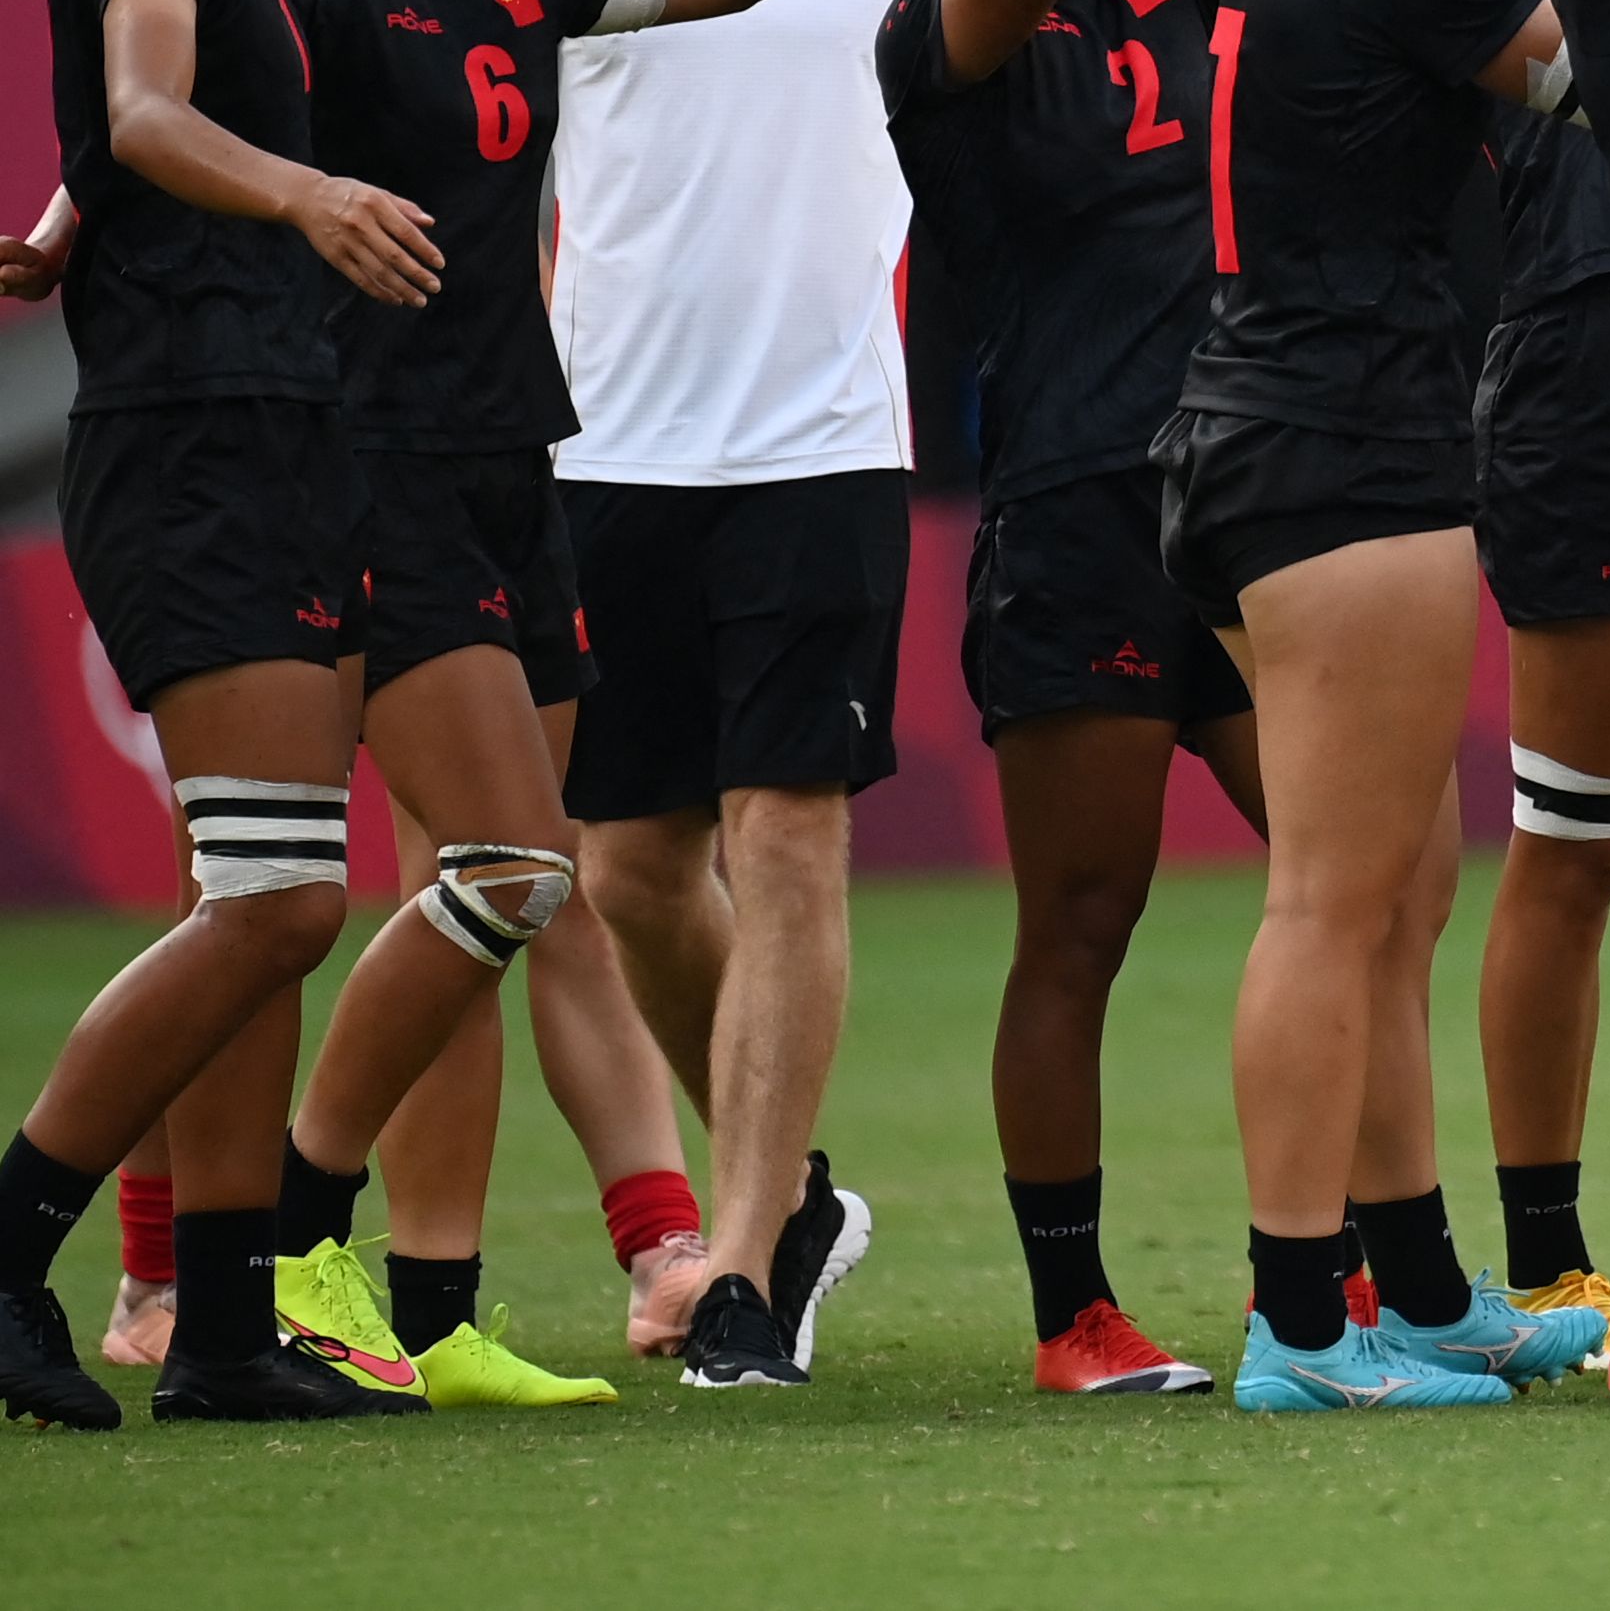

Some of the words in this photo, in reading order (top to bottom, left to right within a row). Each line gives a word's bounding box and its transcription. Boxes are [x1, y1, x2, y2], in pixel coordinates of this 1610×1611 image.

[464, 45, 530, 163] 6
[1107, 39, 1184, 156] 2
[1031, 1218, 1098, 1239] AONE
